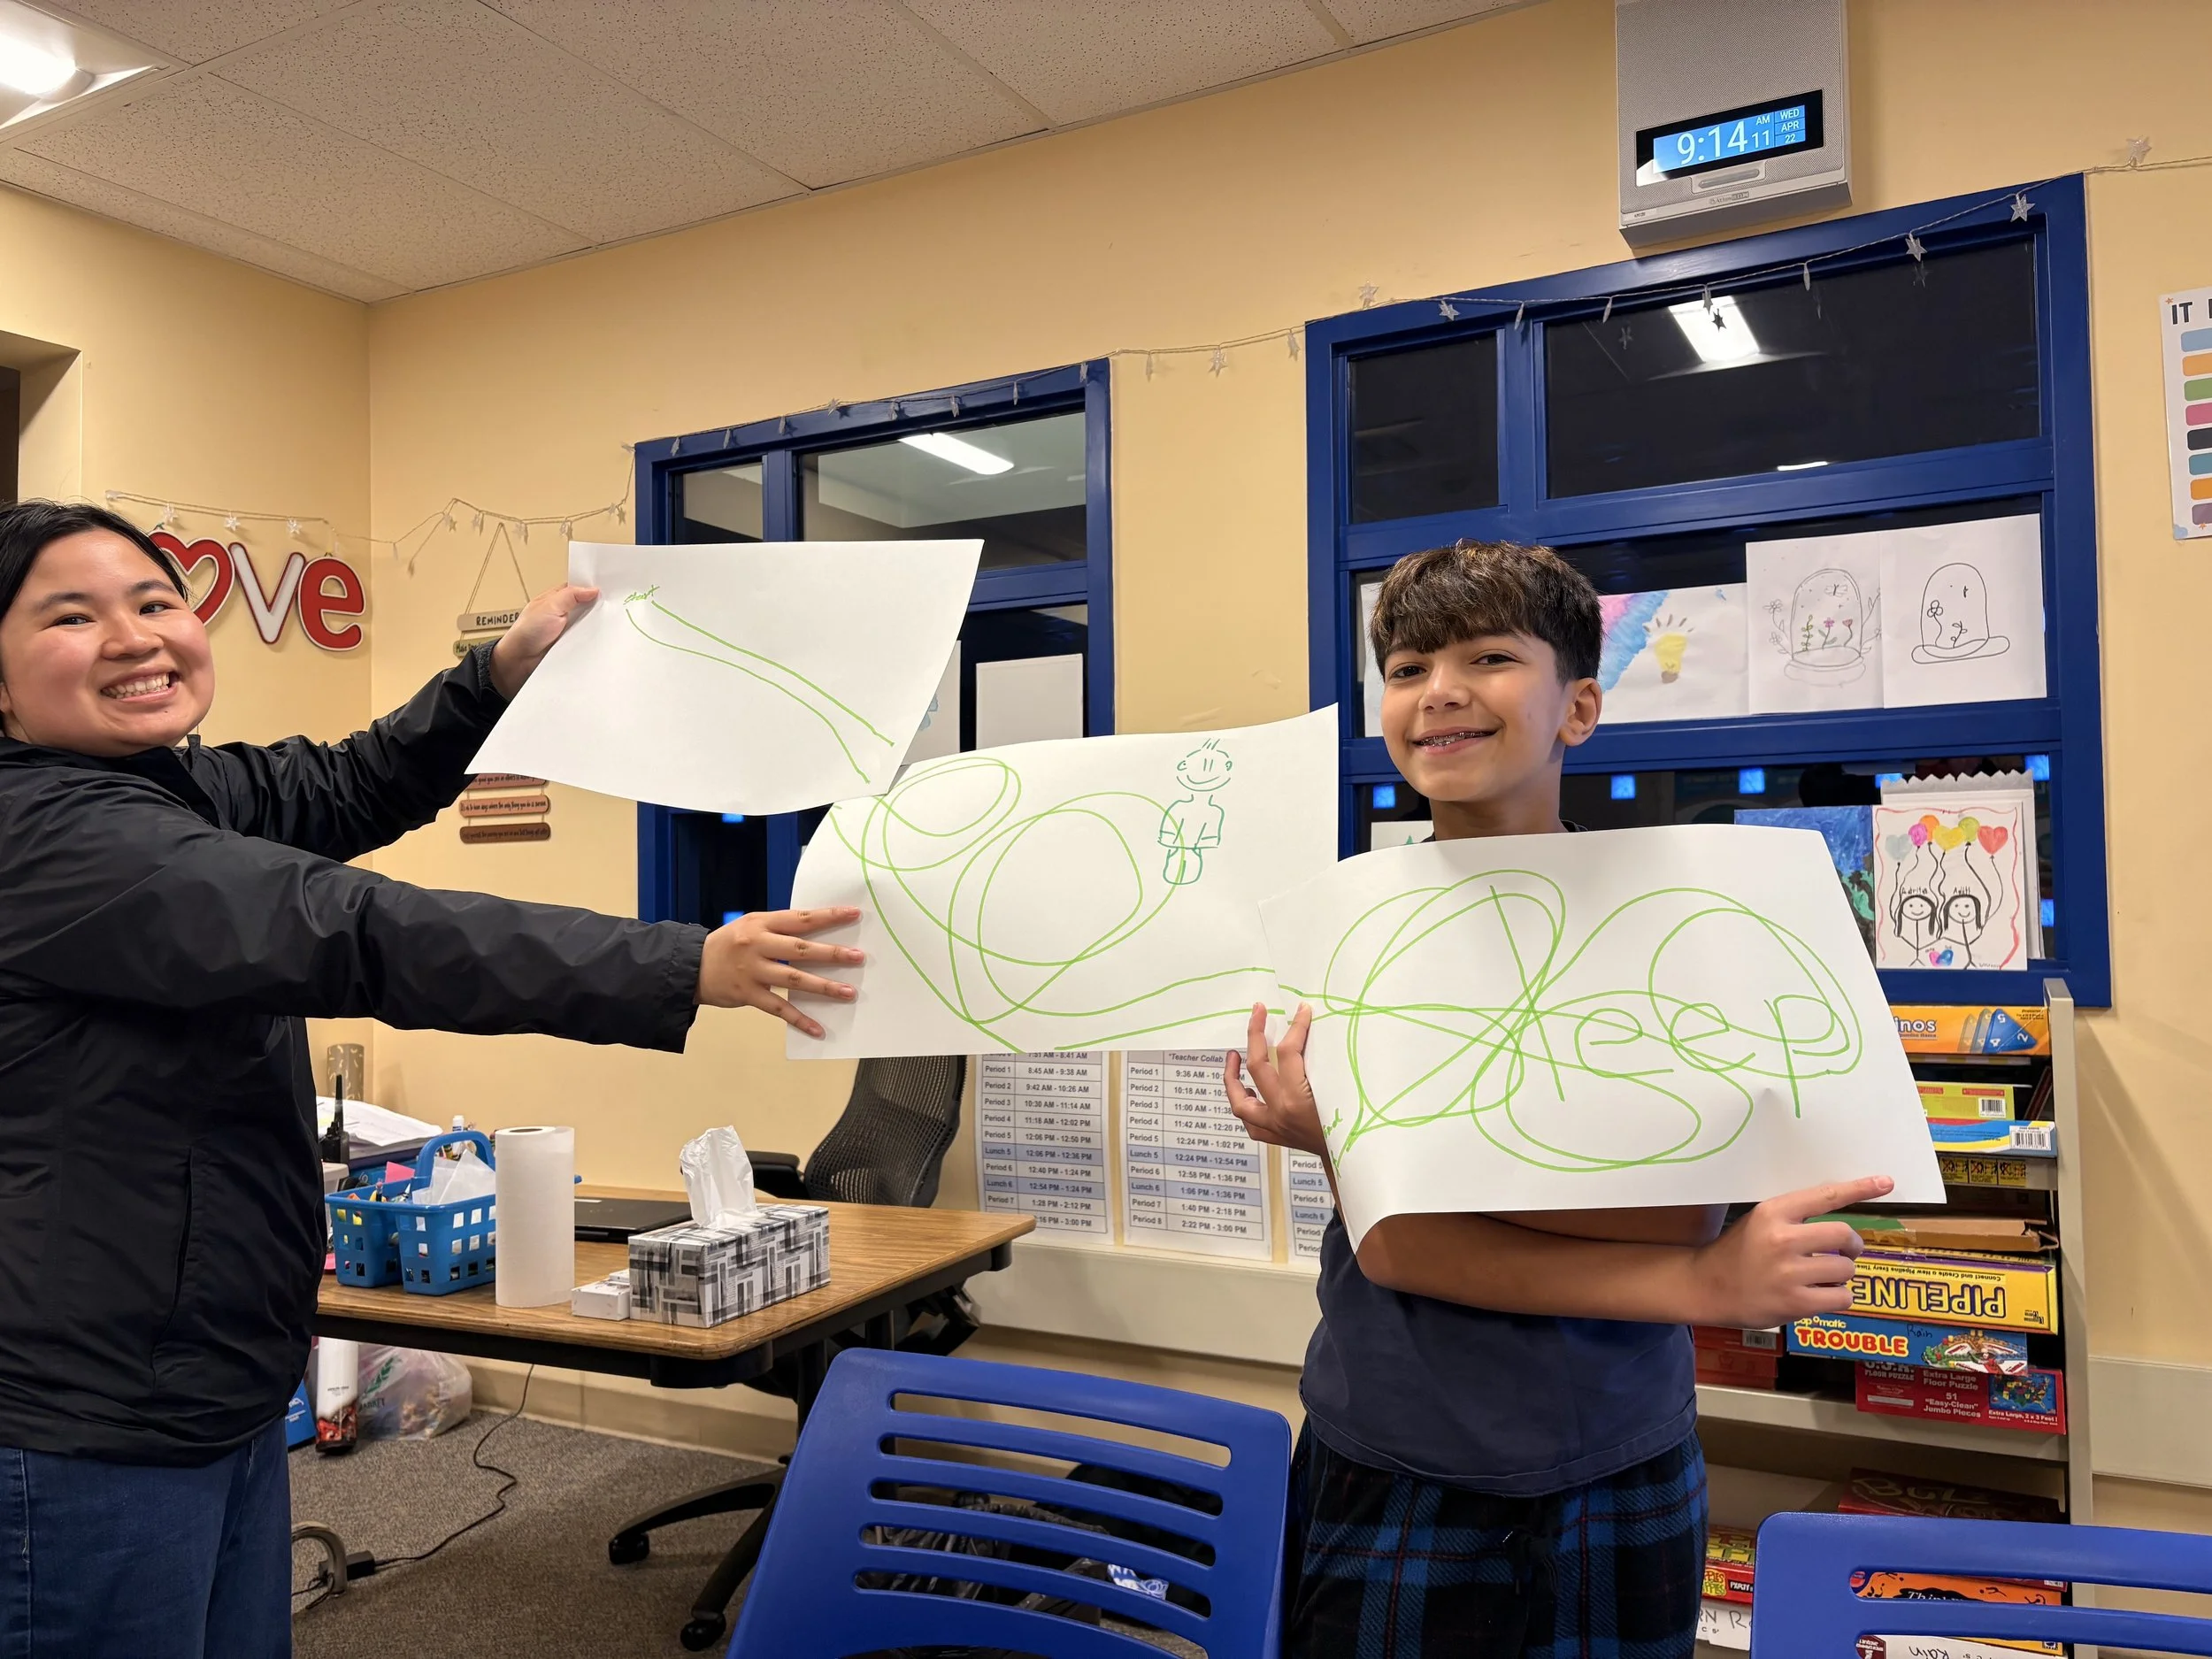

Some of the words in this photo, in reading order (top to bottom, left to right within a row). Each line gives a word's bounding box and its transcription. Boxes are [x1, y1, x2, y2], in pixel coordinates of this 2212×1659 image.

[1755, 114, 1770, 126] AM
[1779, 109, 1800, 120] WED
[1780, 120, 1800, 132] APR
[1677, 120, 1748, 165] 9:14
[1752, 130, 1770, 149] 11
[1785, 134, 1796, 144] 22
[2171, 302, 2193, 325] IT
[1851, 1275, 2006, 1318] PIPELINE
[1906, 1323, 1933, 1339] Rain
[1794, 1327, 1909, 1357] TROUBLE
[1923, 1370, 1947, 1379] Extra
[1949, 1372, 1977, 1383] Large
[1924, 1378, 1947, 1386] Floor
[1948, 1380, 1978, 1390] Puzzle
[1946, 1392, 1957, 1401] 51
[1924, 1404, 1951, 1414] Jumbo
[1953, 1408, 1981, 1418] Pieces
